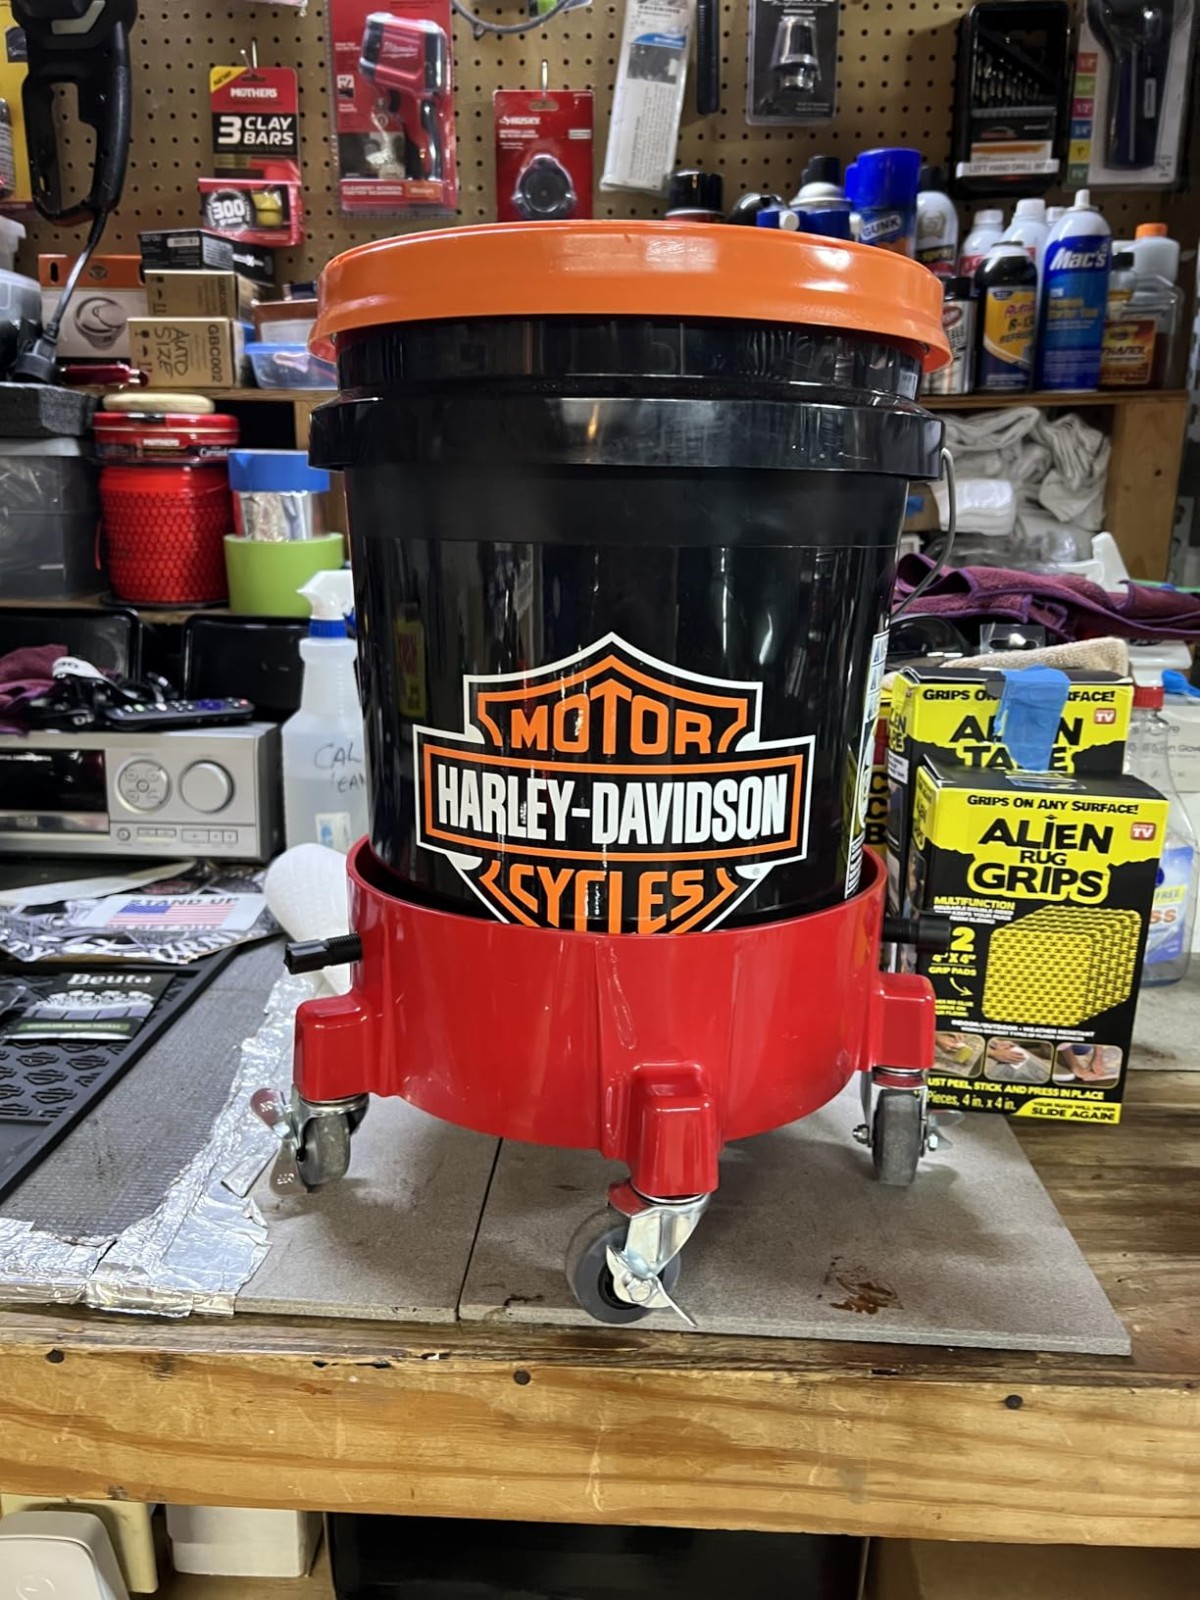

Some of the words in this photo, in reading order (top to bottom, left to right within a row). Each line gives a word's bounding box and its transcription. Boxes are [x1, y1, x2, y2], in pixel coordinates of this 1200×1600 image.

[229, 87, 278, 99] MOTHERS
[217, 115, 243, 145] 3
[244, 116, 293, 130] CLAY
[243, 131, 295, 146] BARS
[211, 199, 246, 220] 300
[862, 217, 900, 238] GUNK
[1050, 247, 1107, 271] Mac's
[207, 324, 224, 384] GBC002
[922, 689, 970, 701] GRIPS
[510, 678, 712, 755] MOTOR
[963, 746, 1070, 770] TAE
[437, 764, 788, 845] HARLEY-DAVIDSON
[967, 795, 1010, 808] GRIPS
[1013, 797, 1033, 809] ON
[1037, 798, 1068, 811] ANY
[1071, 800, 1139, 815] SURFACE!
[1019, 850, 1067, 866] RUG
[972, 862, 1104, 898] GRIPS
[933, 896, 1016, 911] MULTIFUNCTION
[951, 926, 976, 952] 2
[927, 1077, 947, 1087] UST
[974, 1082, 1002, 1093] STICK
[1004, 1085, 1027, 1095] AND
[1028, 1086, 1058, 1097] PRESS
[1060, 1089, 1071, 1098] IN
[1071, 1090, 1105, 1100] PLACE
[962, 1093, 970, 1107] 4
[994, 1097, 1003, 1109] 4
[1031, 1107, 1067, 1117] SLIDE
